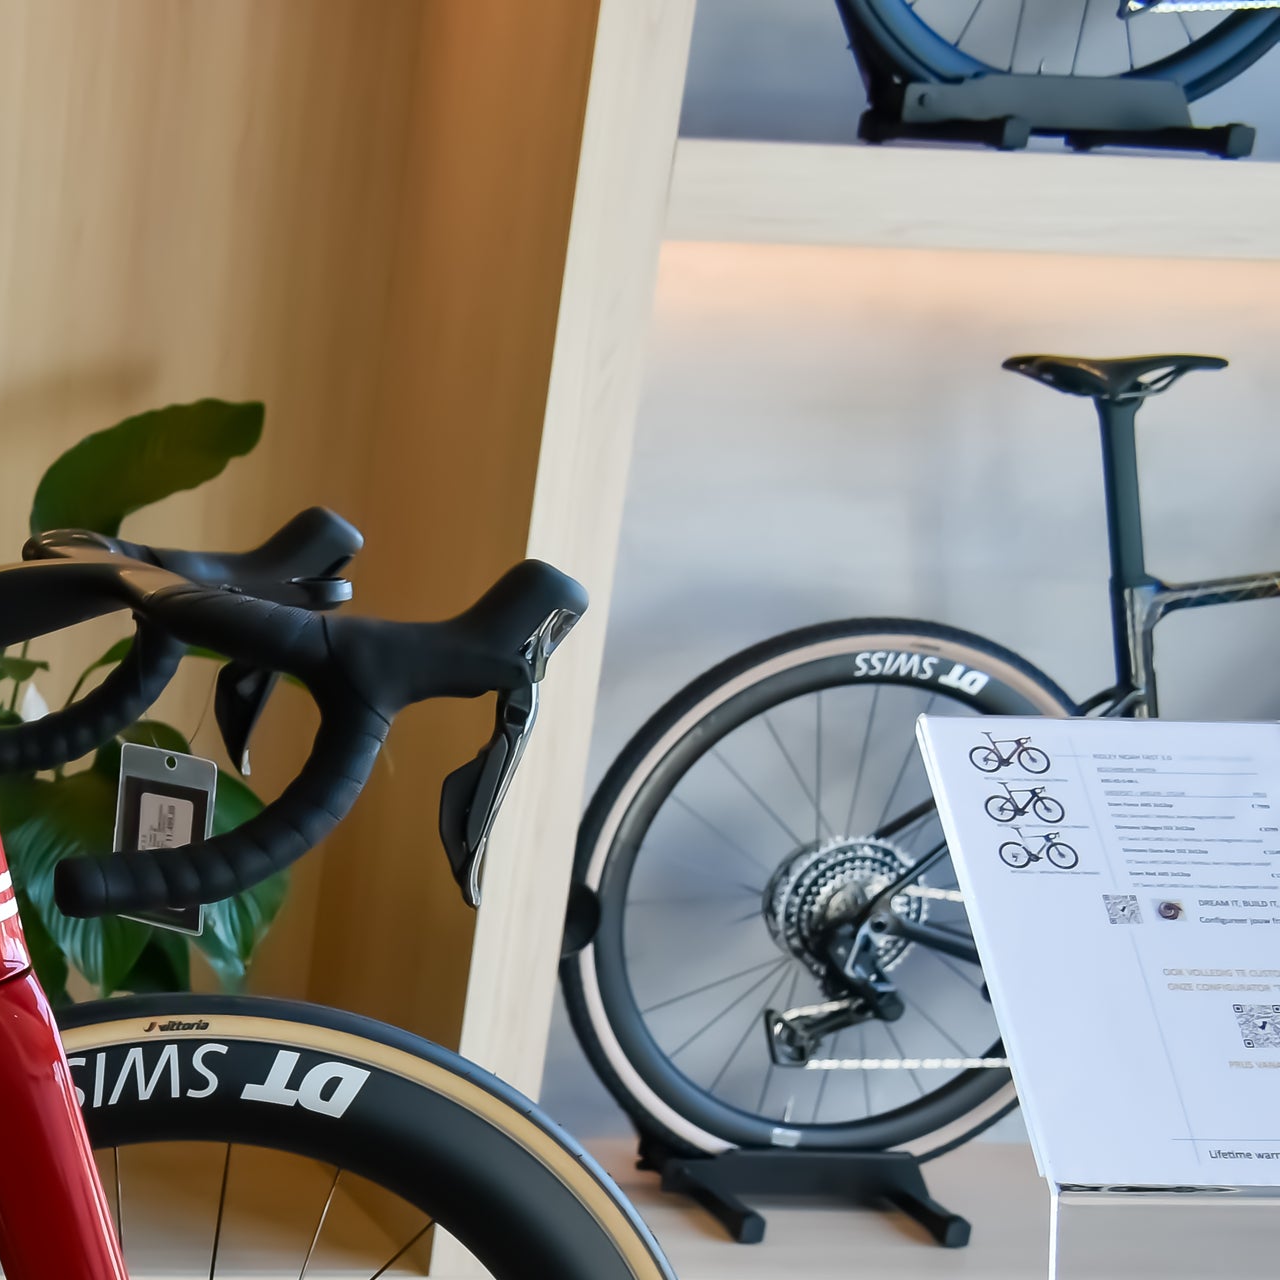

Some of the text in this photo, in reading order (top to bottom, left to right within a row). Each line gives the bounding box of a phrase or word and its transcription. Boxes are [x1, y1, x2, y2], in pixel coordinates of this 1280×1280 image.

[853, 651, 990, 696] DT SWISS
[1198, 899, 1229, 907] DREAM
[1243, 900, 1268, 908] BUILD
[157, 1018, 210, 1033] vittoria
[66, 1042, 371, 1119] DT SWI
[1208, 1149, 1253, 1160] Lifetime
